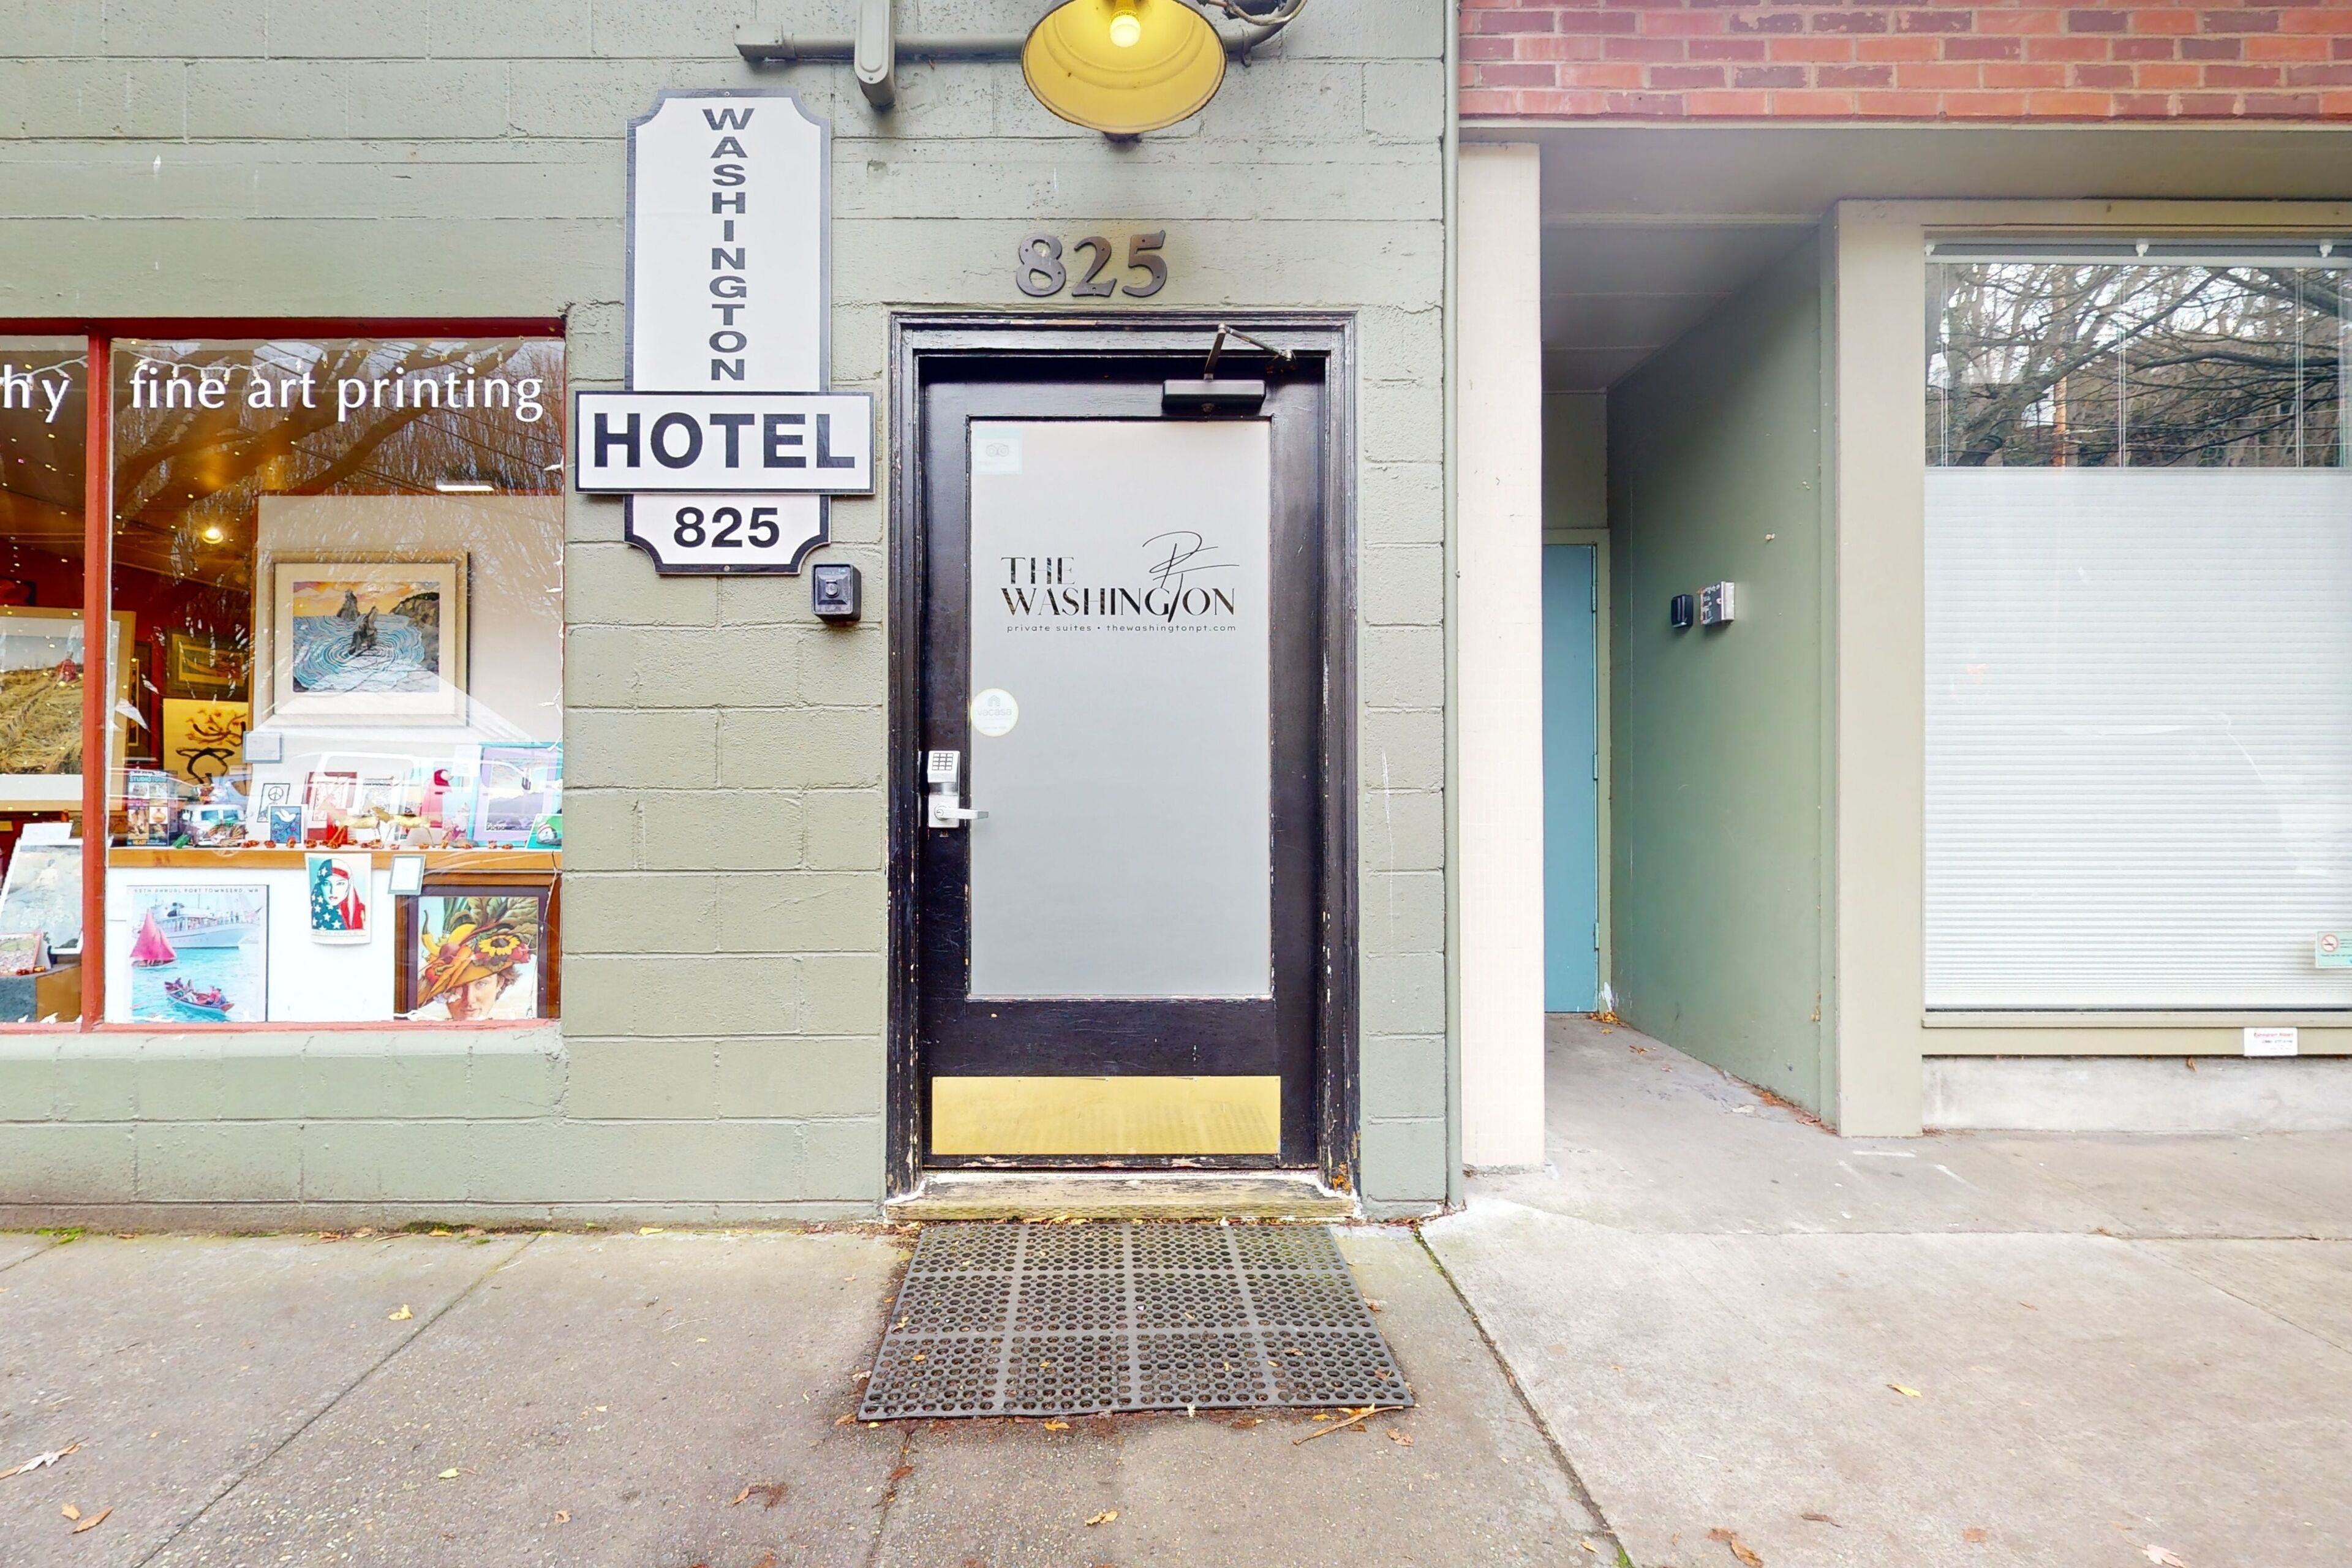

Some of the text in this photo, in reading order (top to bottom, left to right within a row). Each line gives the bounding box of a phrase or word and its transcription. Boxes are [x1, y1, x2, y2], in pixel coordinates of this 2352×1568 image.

[702, 107, 755, 381] WASHINGTON
[1016, 230, 1167, 298] 825
[129, 364, 226, 409] fine
[247, 372, 317, 409] art
[337, 367, 543, 423] printing
[594, 412, 856, 469] HOTEL
[673, 506, 780, 548] 825
[1001, 556, 1076, 585] THE
[1001, 582, 1235, 622] WASHINGTON
[1006, 624, 1051, 633] private
[1106, 624, 1237, 633] thewashingtonpt.com
